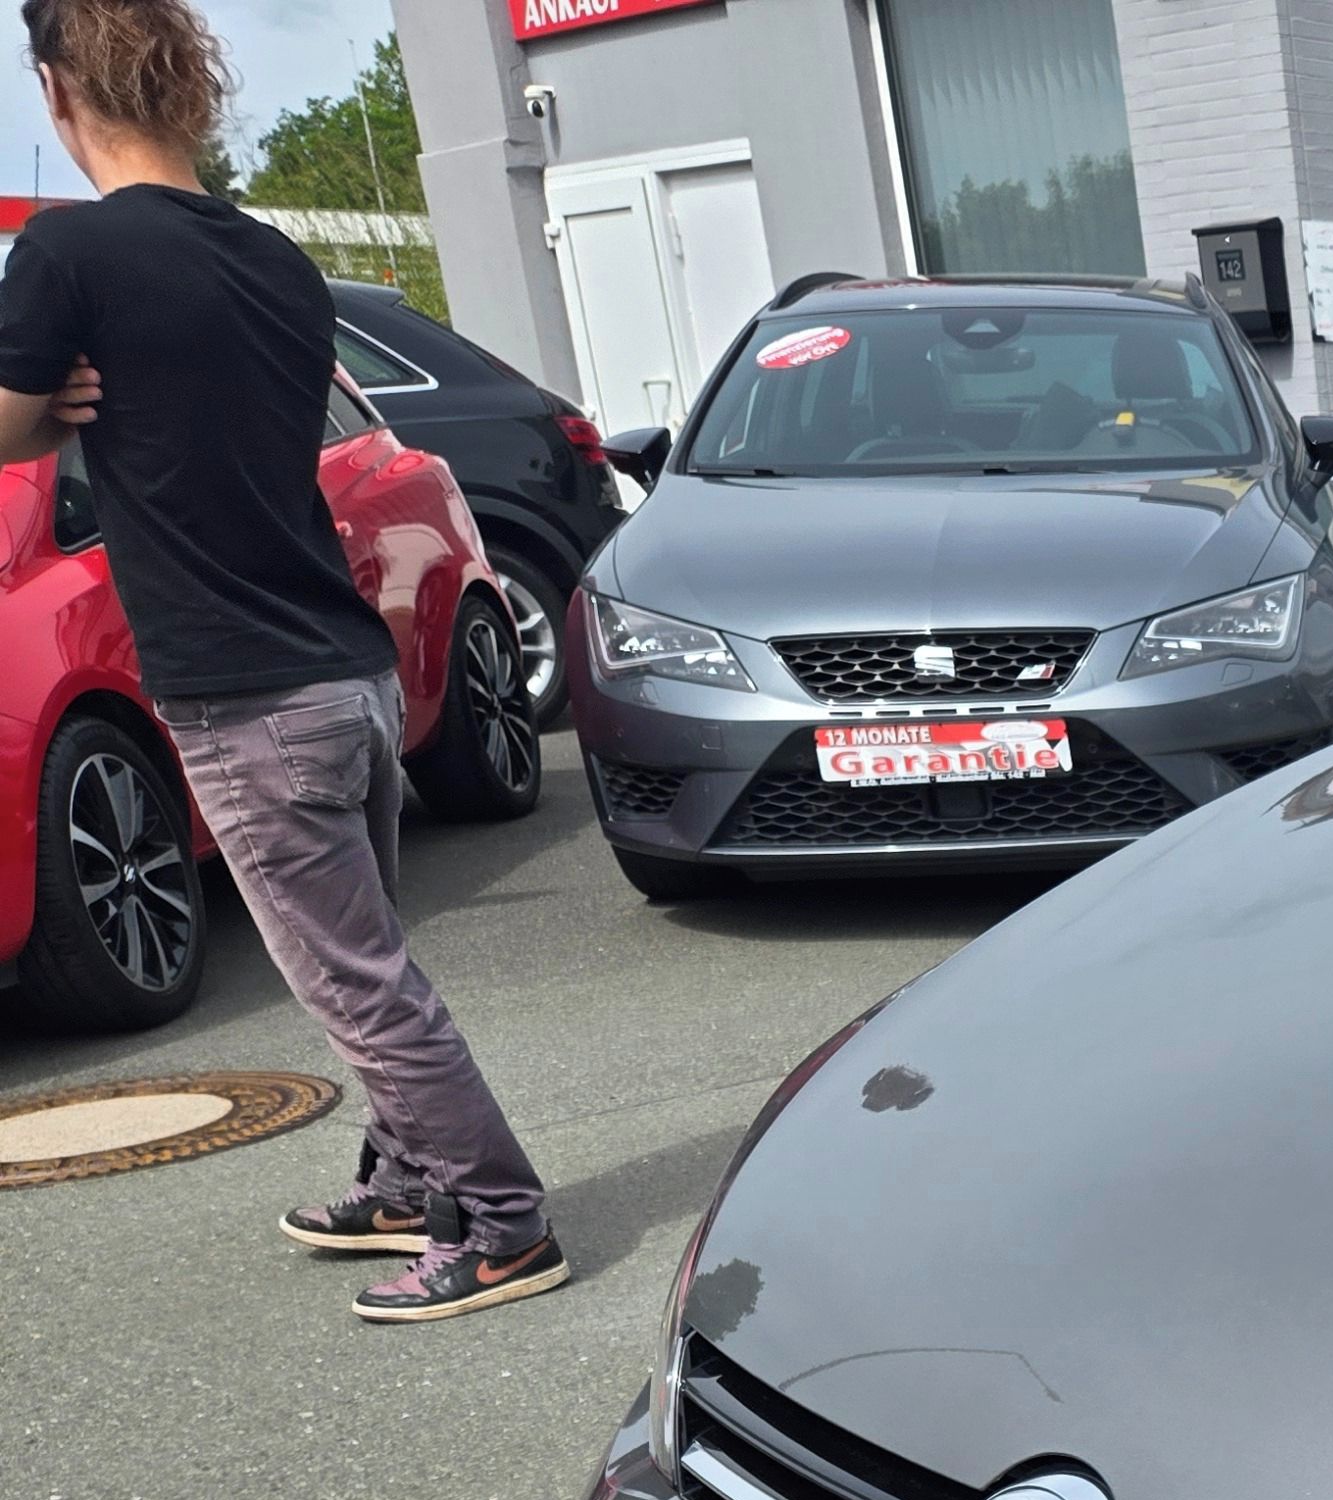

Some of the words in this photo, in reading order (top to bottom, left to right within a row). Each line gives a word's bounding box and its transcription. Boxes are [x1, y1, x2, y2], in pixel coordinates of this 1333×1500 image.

[1219, 260, 1242, 280] 142
[825, 730, 847, 746] 12
[851, 726, 932, 746] MONATE
[830, 743, 1060, 777] Garantie
